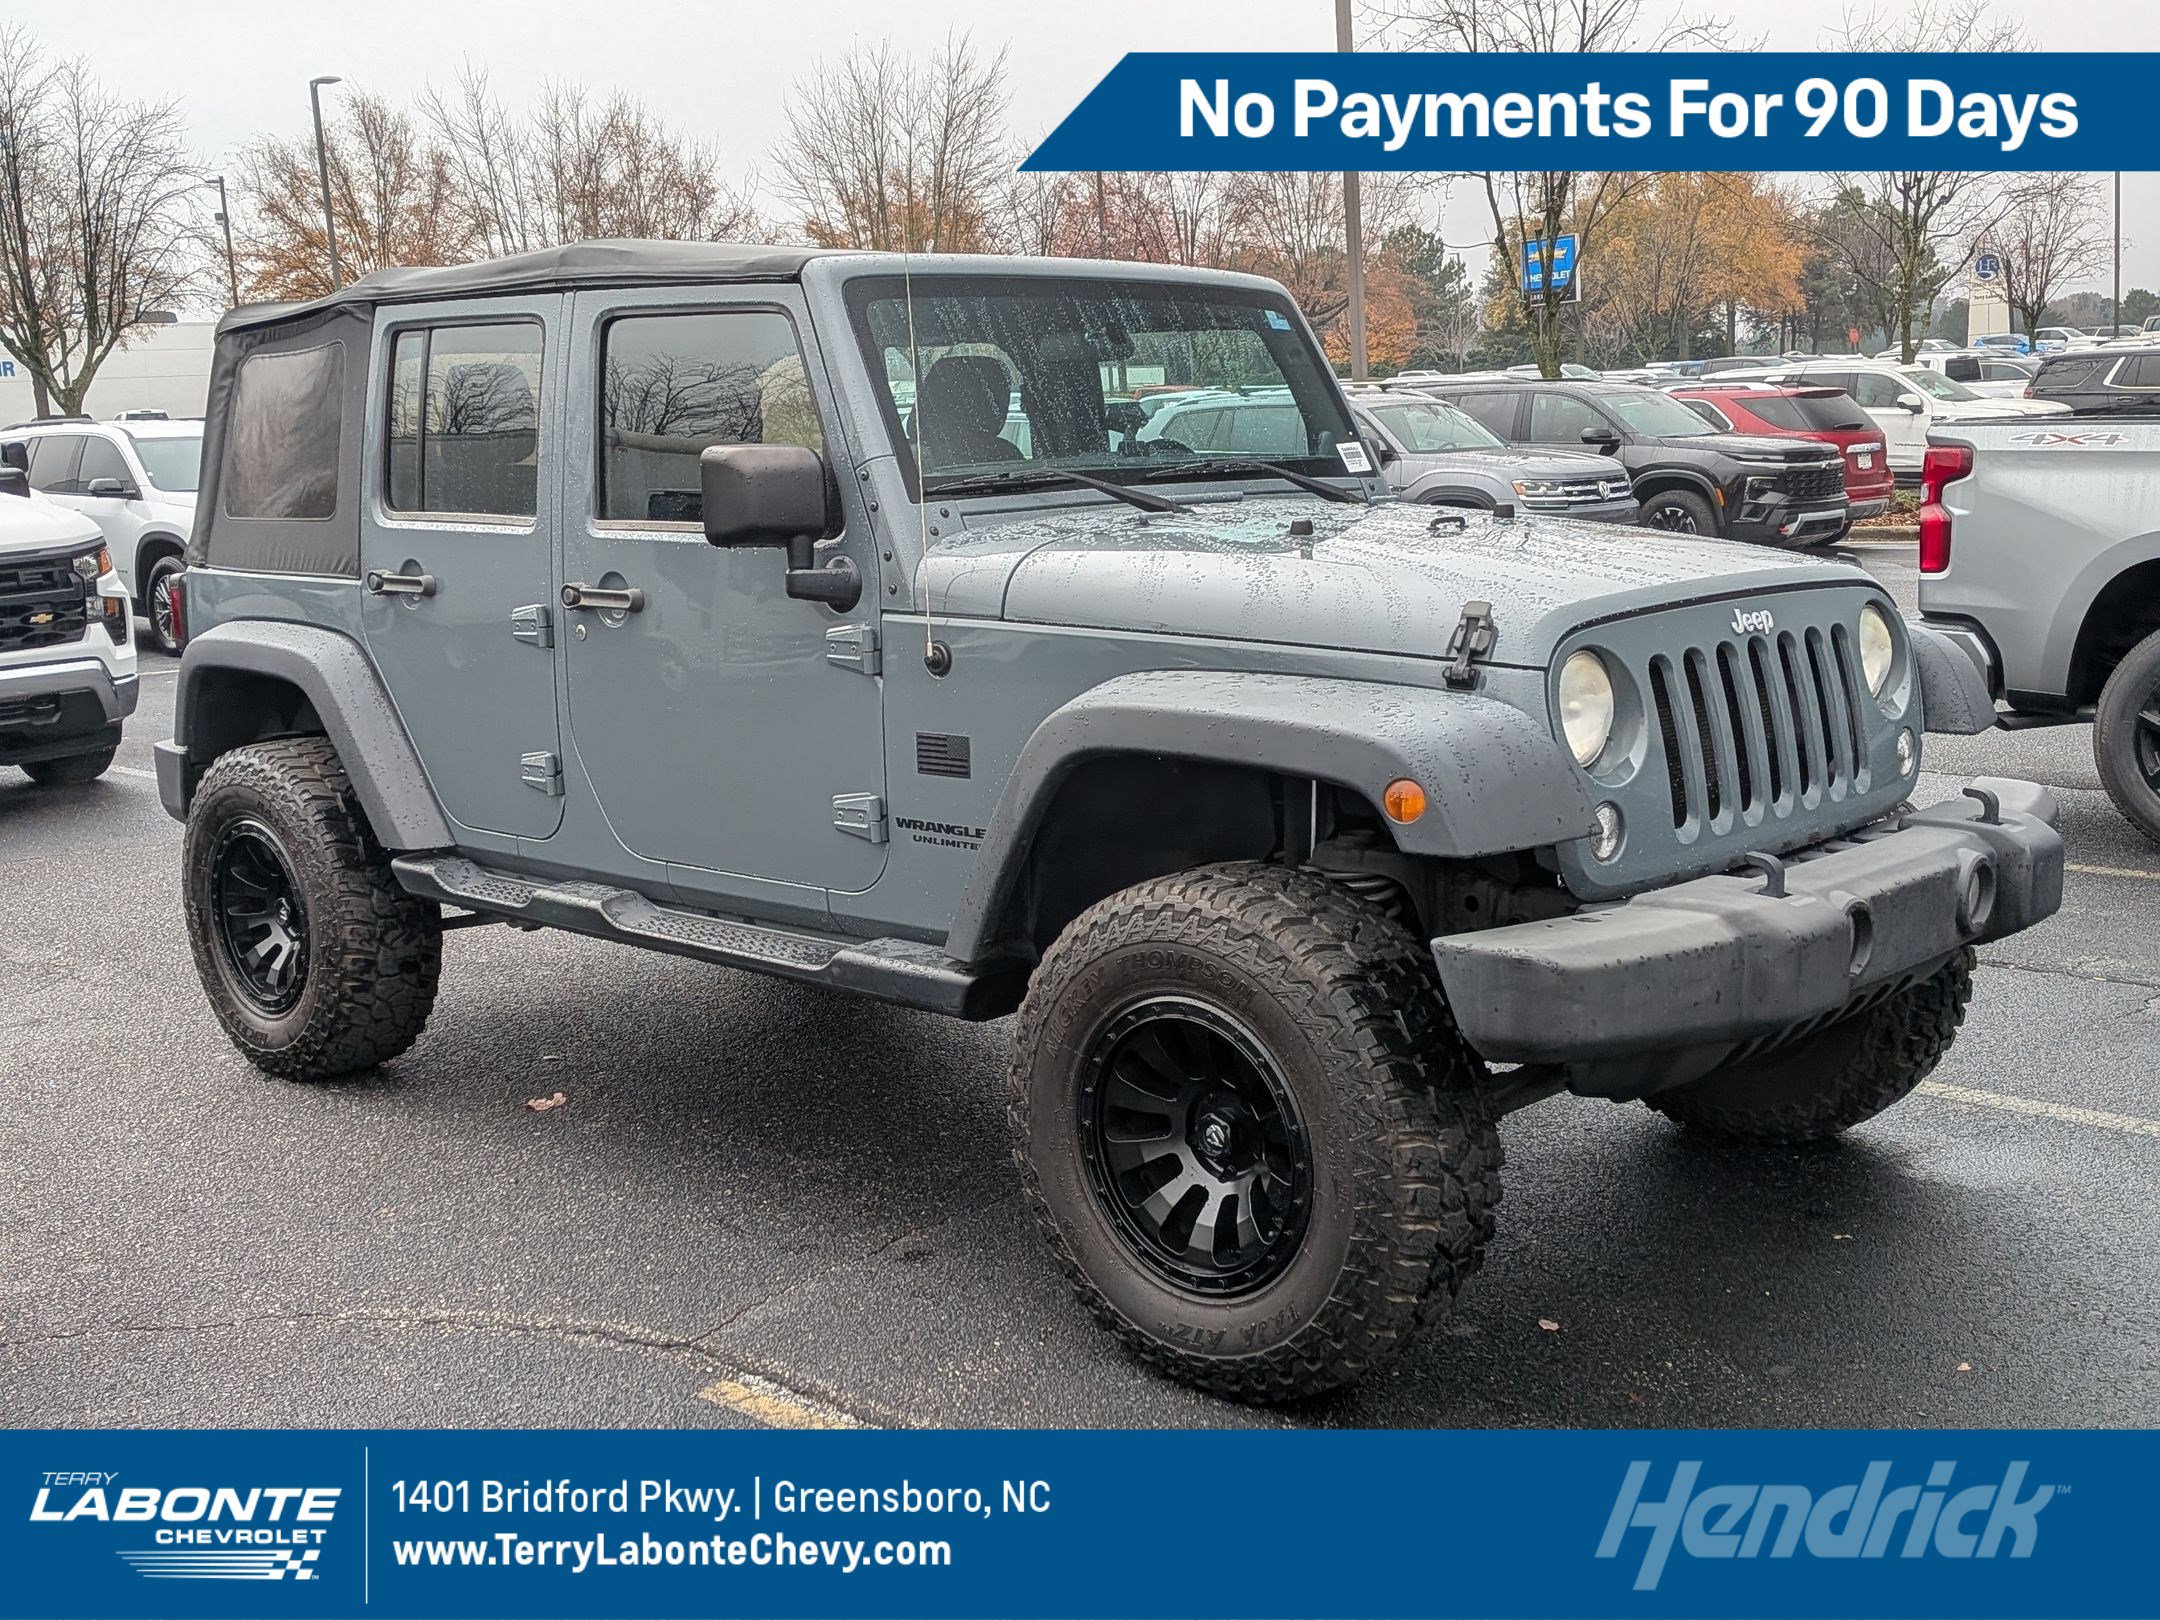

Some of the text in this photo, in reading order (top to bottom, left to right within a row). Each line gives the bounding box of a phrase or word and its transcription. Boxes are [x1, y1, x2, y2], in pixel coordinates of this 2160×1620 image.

[1525, 269, 1571, 284] HEOLET
[1731, 608, 1774, 635] Jeep
[895, 817, 987, 839] WRANGLE
[913, 834, 981, 851] UNLIMITE
[1043, 949, 1261, 1059] MICKEY THOMPSON
